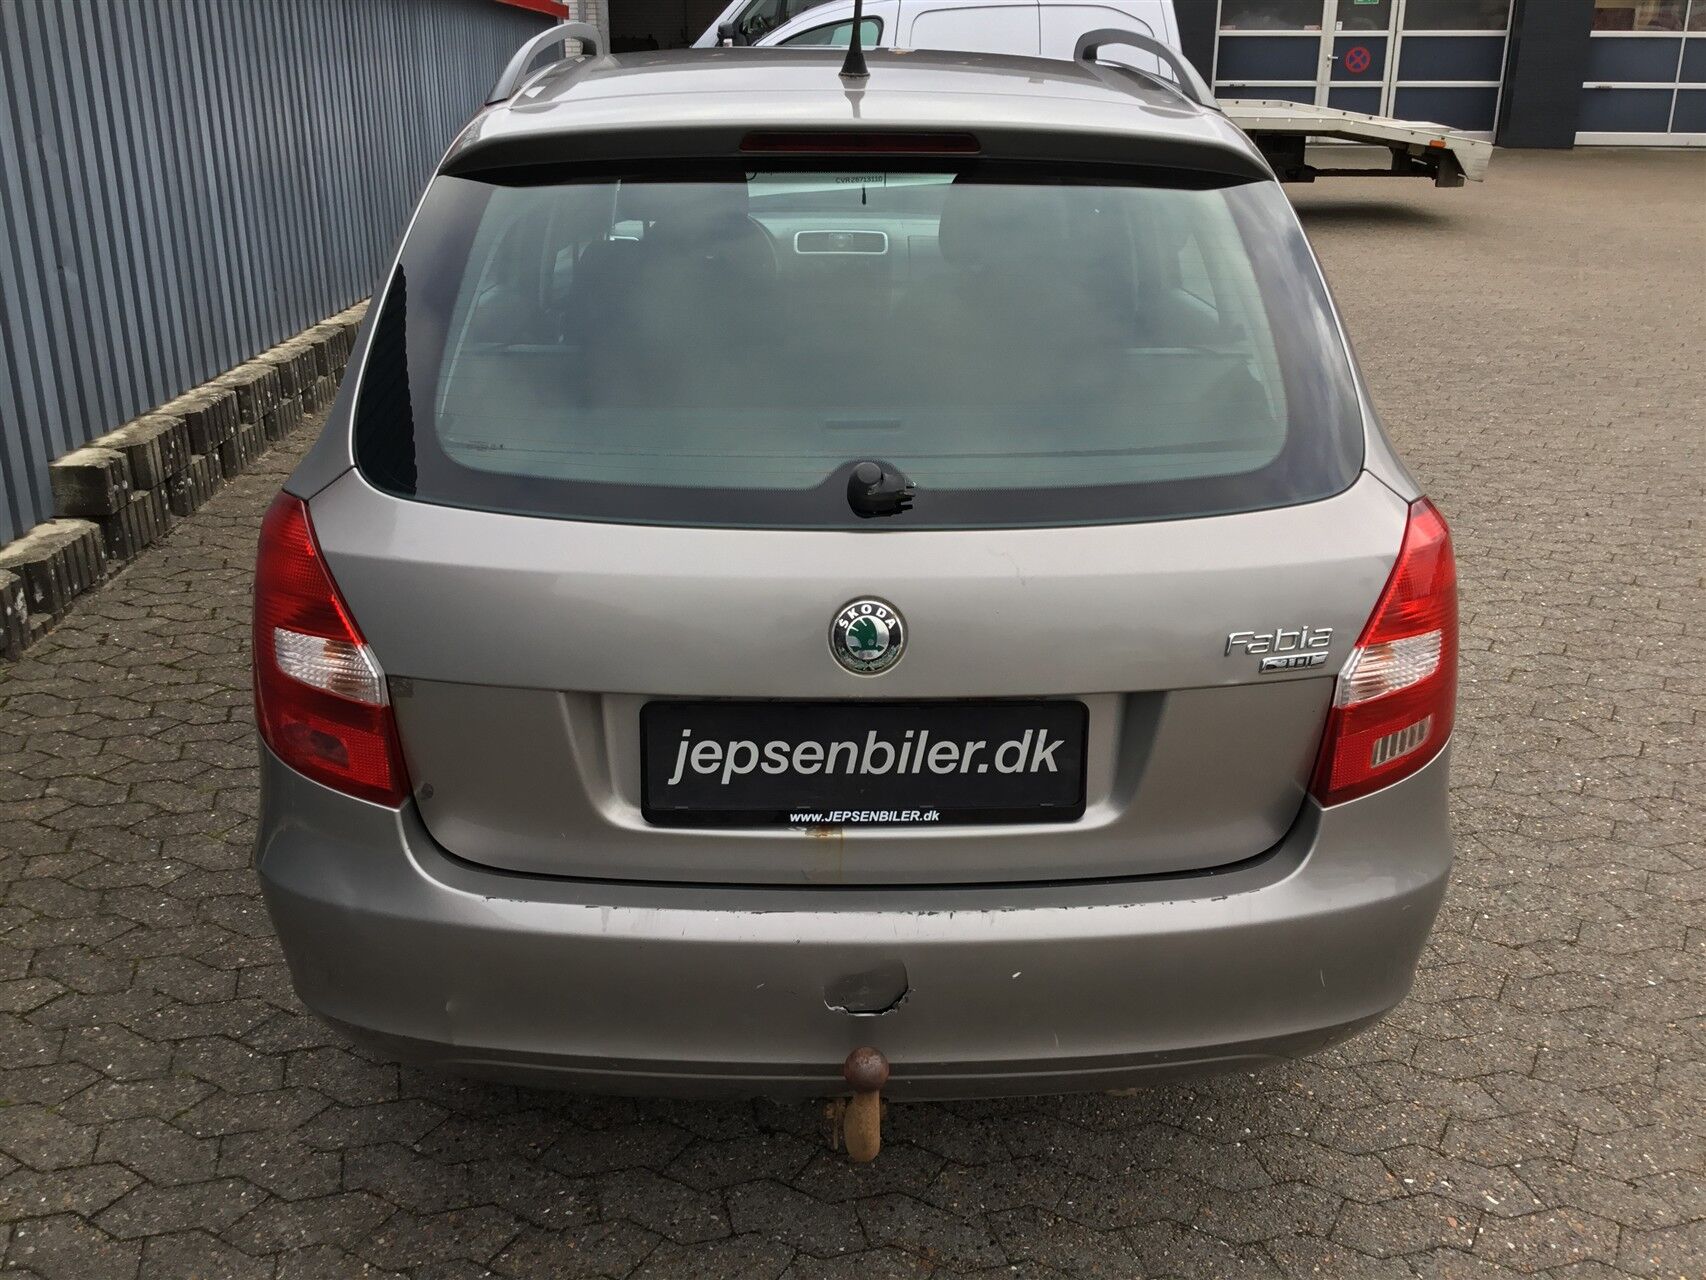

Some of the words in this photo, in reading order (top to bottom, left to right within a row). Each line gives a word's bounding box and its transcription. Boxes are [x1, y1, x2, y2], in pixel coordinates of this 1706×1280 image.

[1225, 625, 1333, 656] Fabia
[667, 729, 1065, 785] jepsenbiler.dk
[789, 810, 940, 822] www.JEPSENBILER.dk
